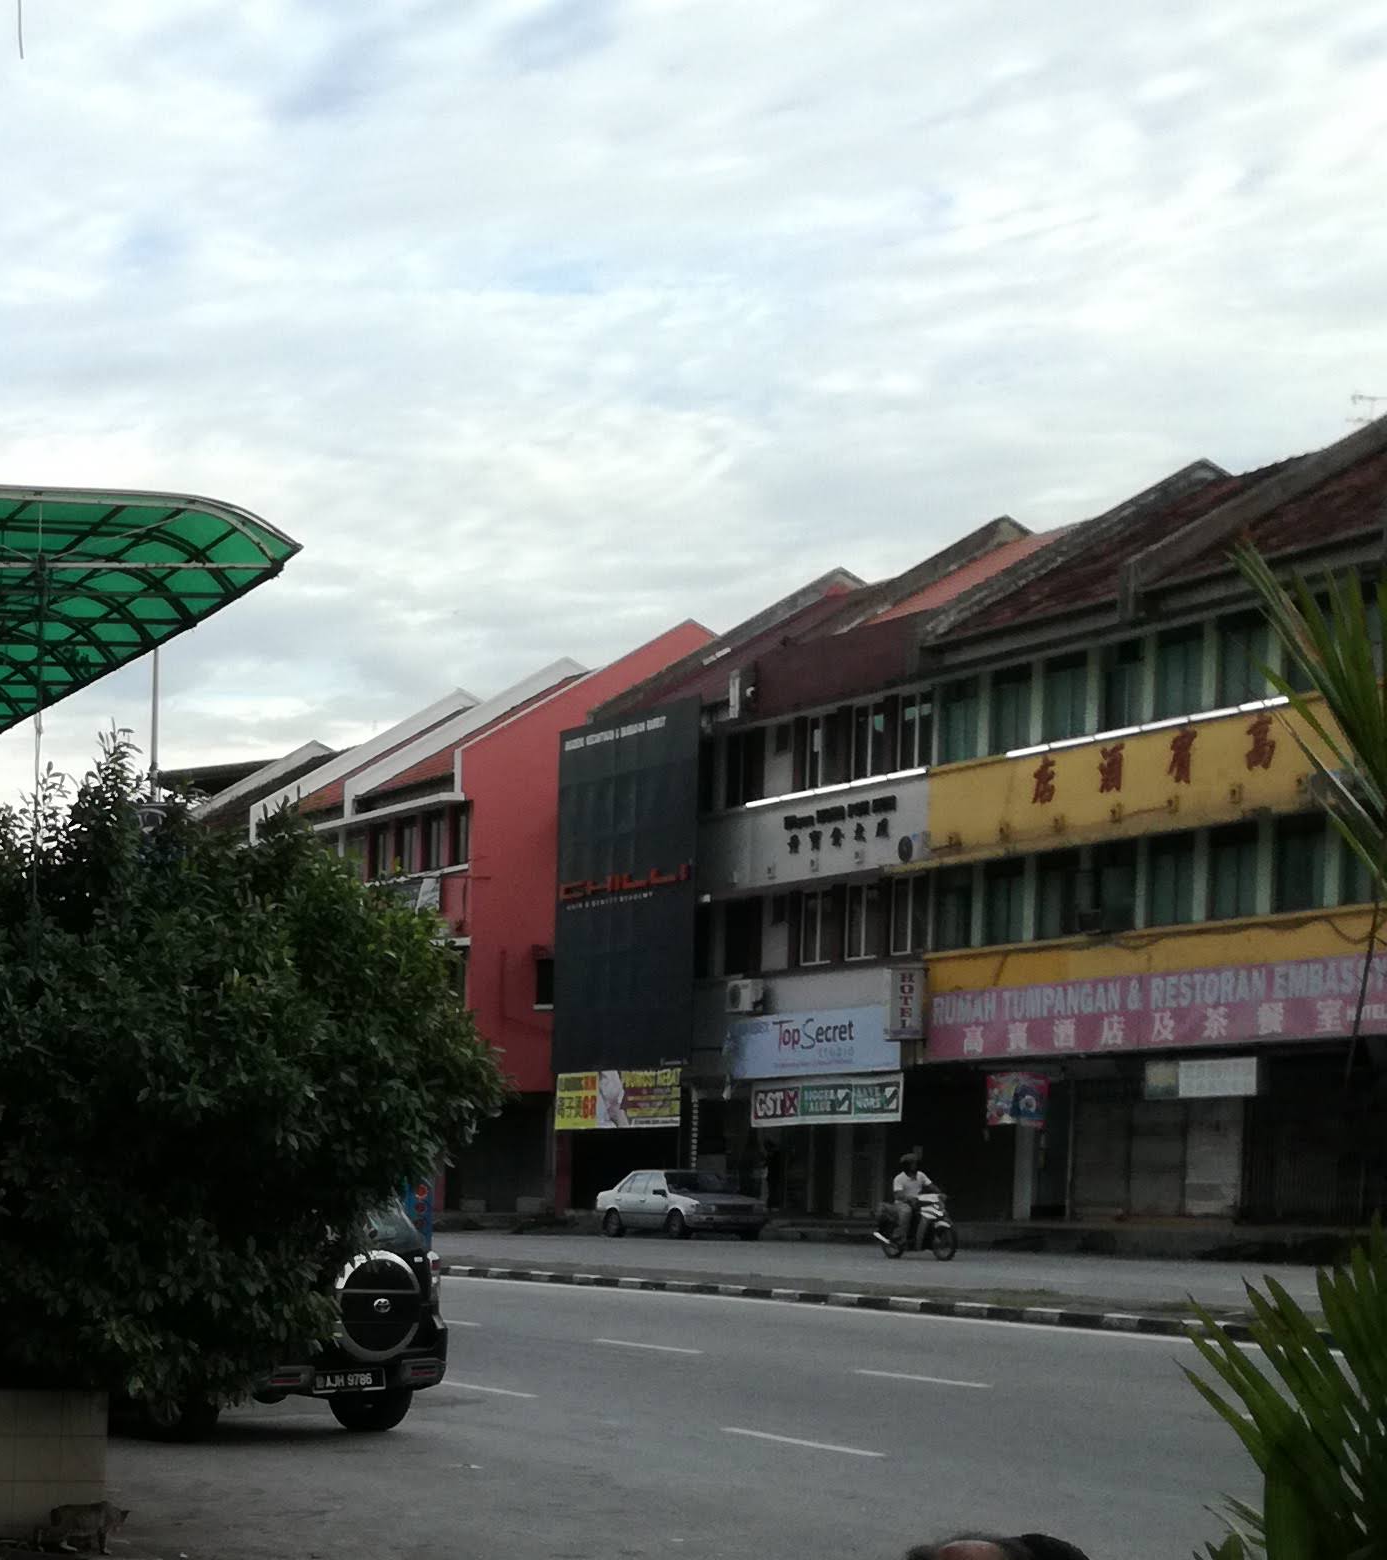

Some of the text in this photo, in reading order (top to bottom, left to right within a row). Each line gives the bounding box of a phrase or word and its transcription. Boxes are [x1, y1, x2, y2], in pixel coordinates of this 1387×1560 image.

[932, 992, 997, 1025] RUMAH
[1002, 980, 1121, 1020] TUMPANGAN
[1127, 978, 1142, 1009] &
[1150, 967, 1267, 1009] RESTORAN
